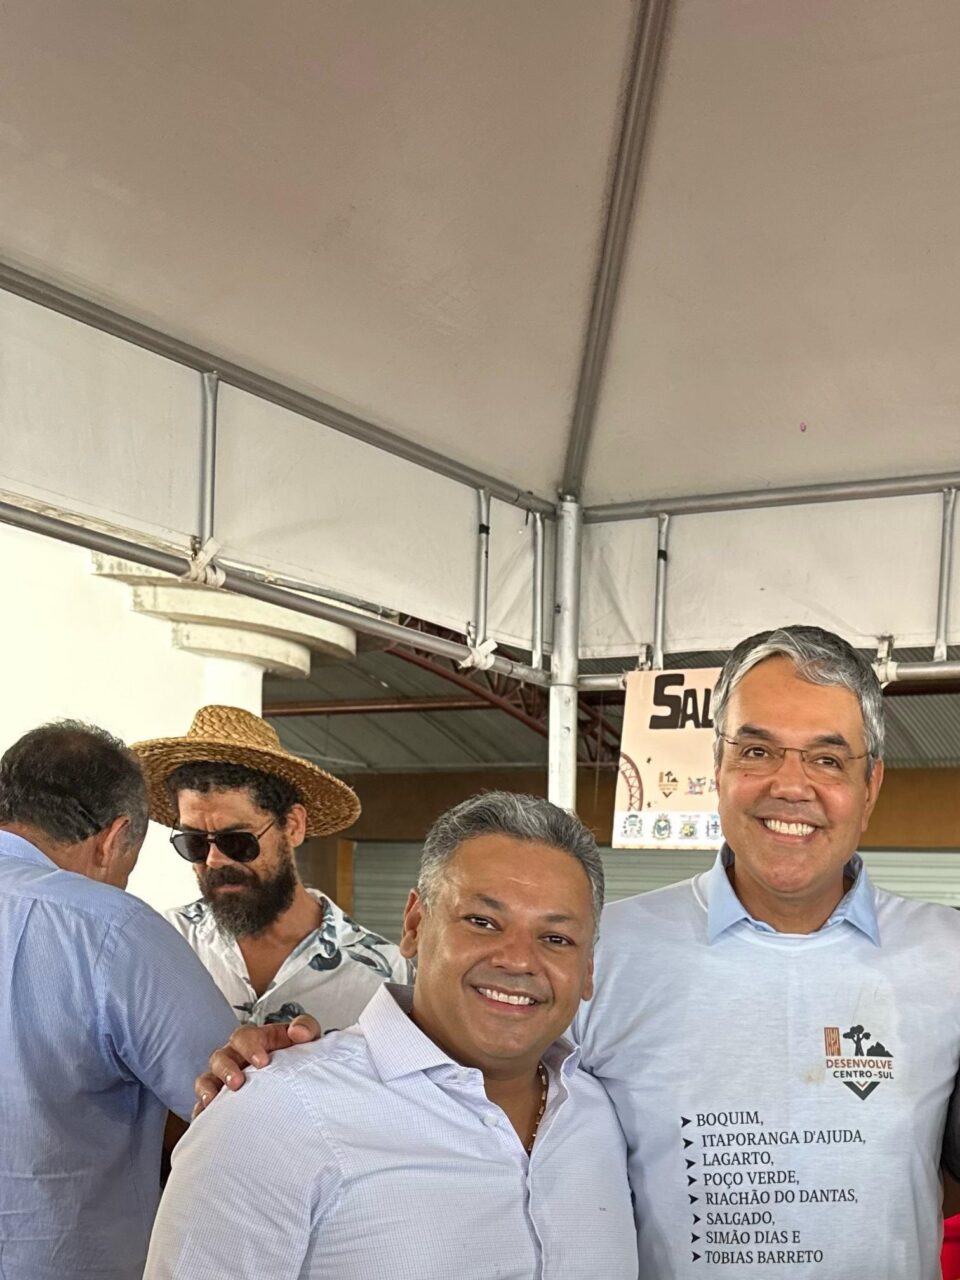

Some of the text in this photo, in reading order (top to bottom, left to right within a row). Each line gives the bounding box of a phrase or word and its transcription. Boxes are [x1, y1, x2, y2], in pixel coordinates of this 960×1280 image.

[649, 673, 714, 730] SAL
[826, 1059, 893, 1070] DESENVOLVE
[833, 1070, 894, 1080] CENTRO-SUL
[696, 1111, 764, 1127] BOQUIM,
[702, 1129, 866, 1148] ITAPORANGA D'AJUDA,
[702, 1151, 774, 1167] LAGARTO,
[703, 1170, 800, 1189] POÇO VERDE,
[705, 1188, 858, 1206] RIACHÃO DO DANTAS,
[706, 1211, 776, 1226] SALGADO,
[706, 1229, 801, 1245] SIMÃO DIAS E
[705, 1250, 824, 1264] TOBIAS BARRETO
